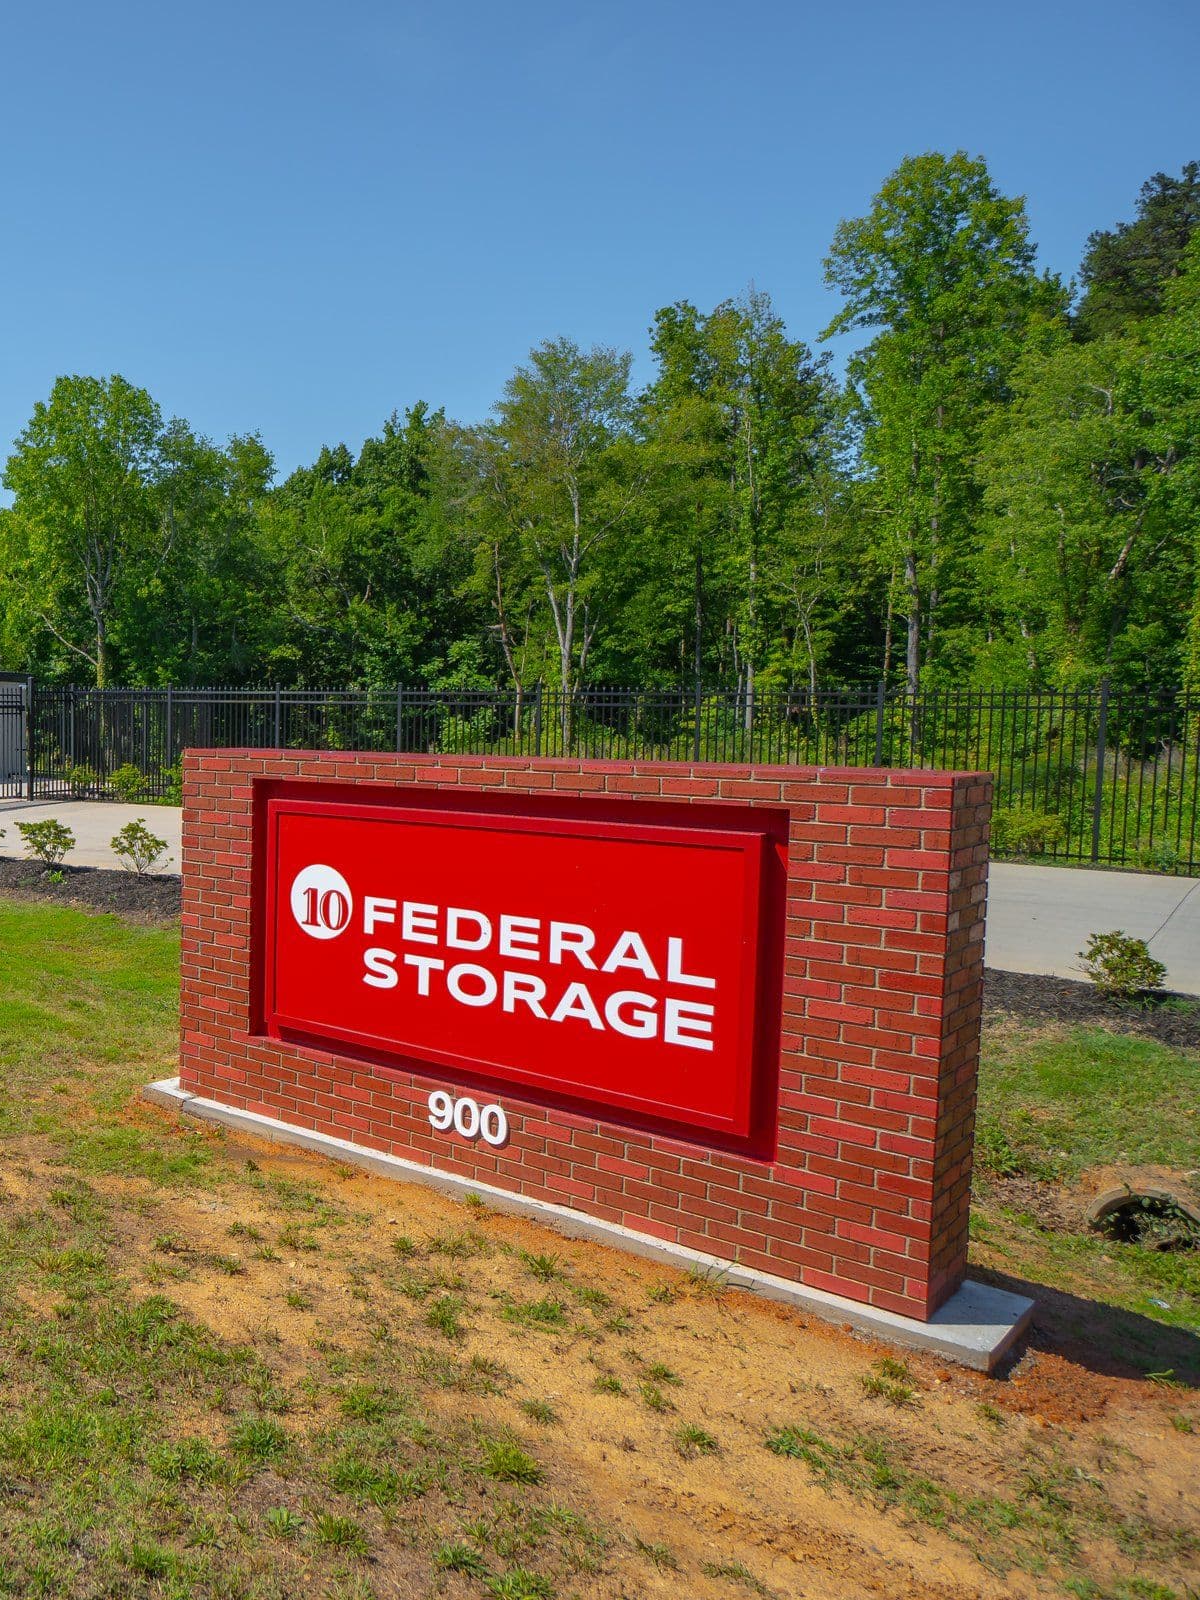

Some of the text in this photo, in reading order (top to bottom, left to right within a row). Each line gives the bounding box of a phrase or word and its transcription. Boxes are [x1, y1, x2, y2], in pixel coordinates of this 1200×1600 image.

[301, 887, 716, 989] 10 FEDERAL
[362, 947, 715, 1051] STORAGE
[427, 1090, 508, 1146] 900
